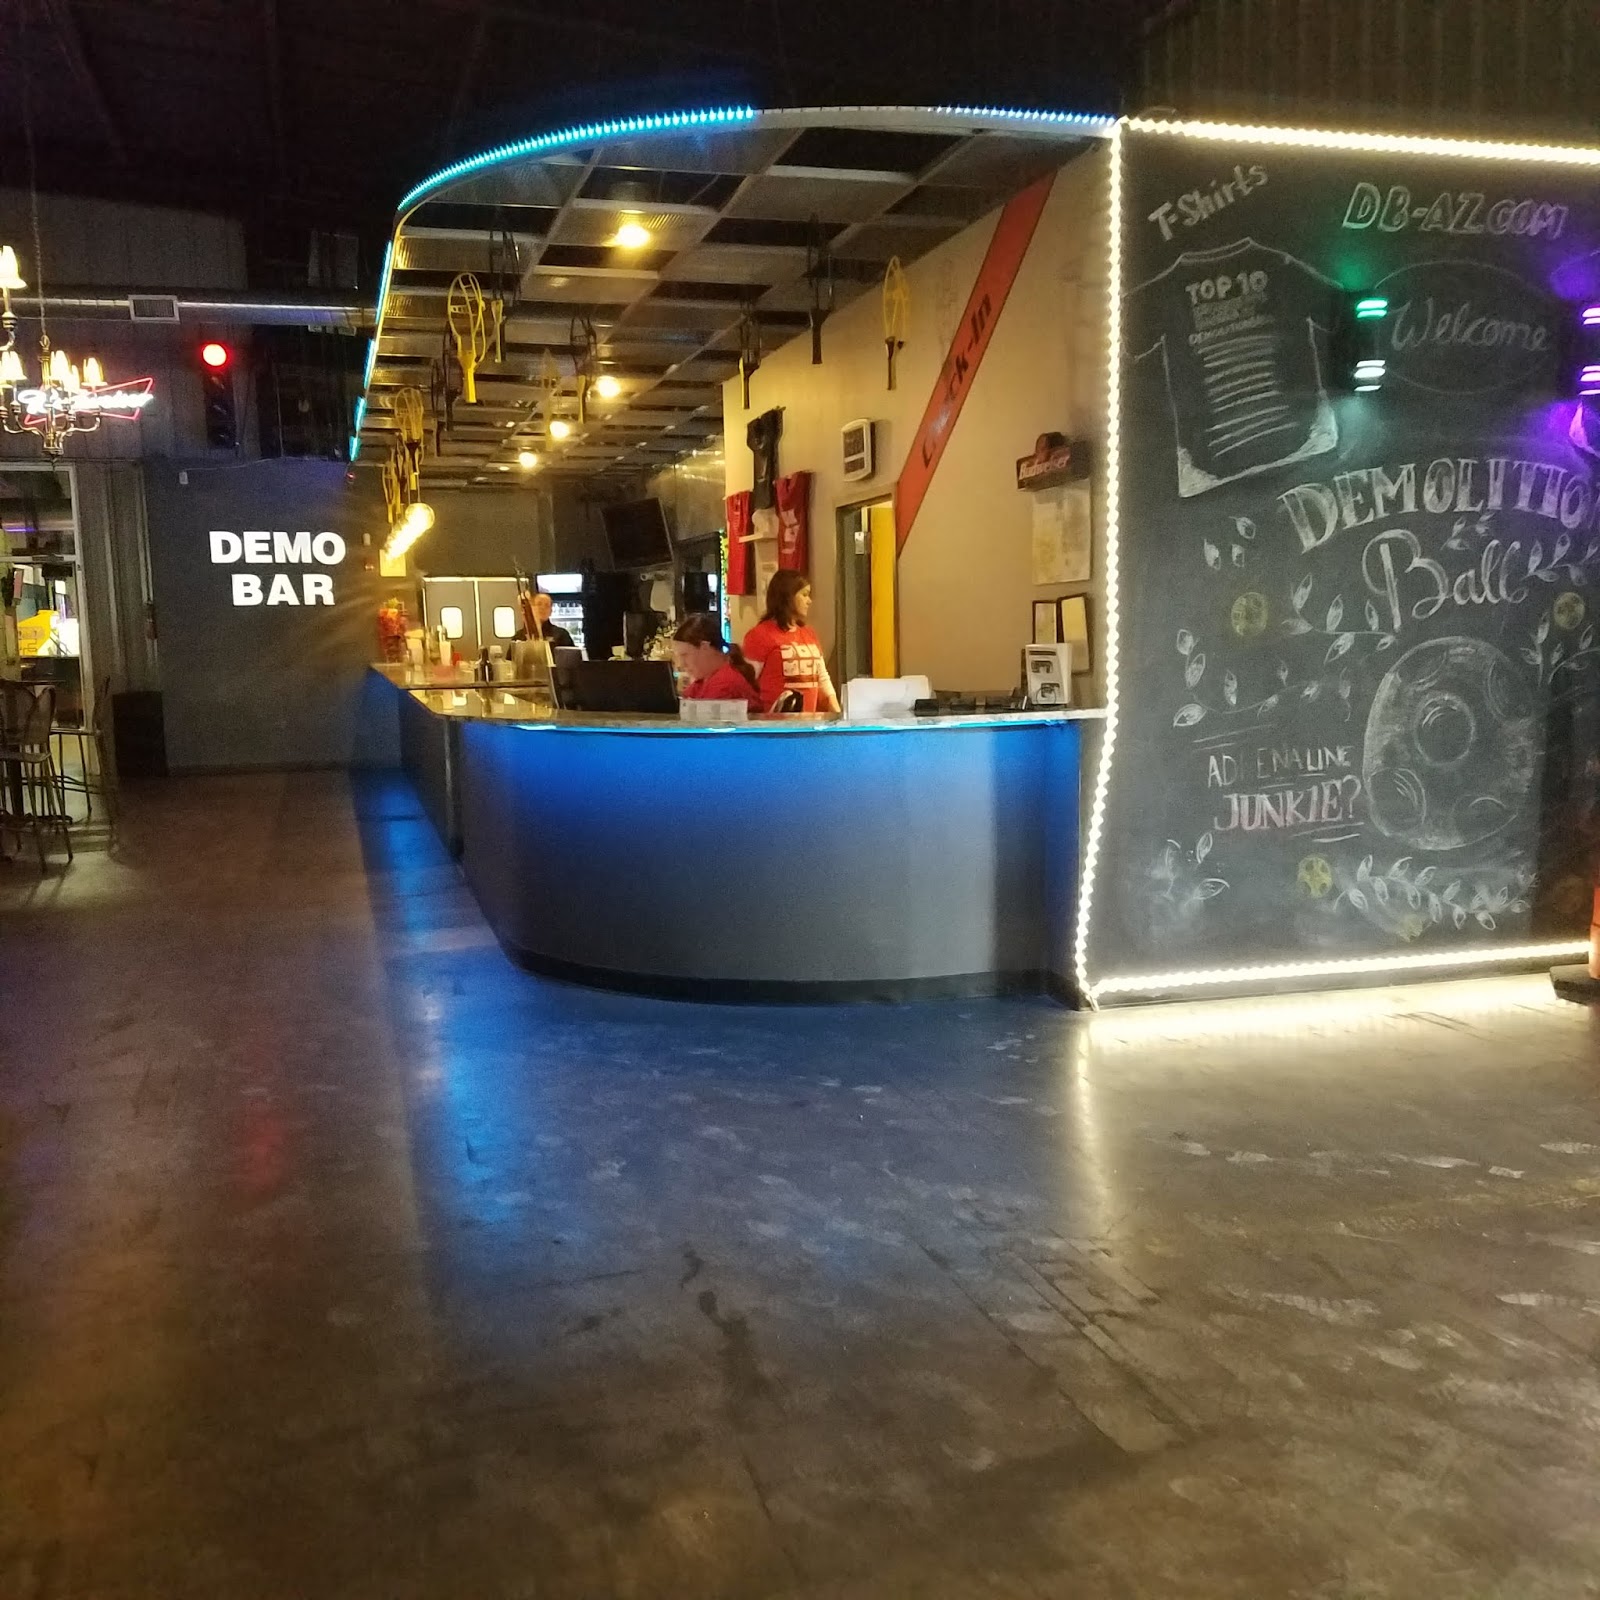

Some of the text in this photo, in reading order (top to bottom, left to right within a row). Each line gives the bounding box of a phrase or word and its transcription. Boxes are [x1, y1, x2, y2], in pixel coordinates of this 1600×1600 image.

[1185, 270, 1268, 305] TOP 10
[1387, 298, 1549, 351] Welcome
[209, 531, 346, 565] DEMO
[231, 573, 336, 606] BAR
[1362, 529, 1529, 632] Ball
[1208, 745, 1354, 788] ADENALINE
[1214, 774, 1362, 831] JUNKIE?
